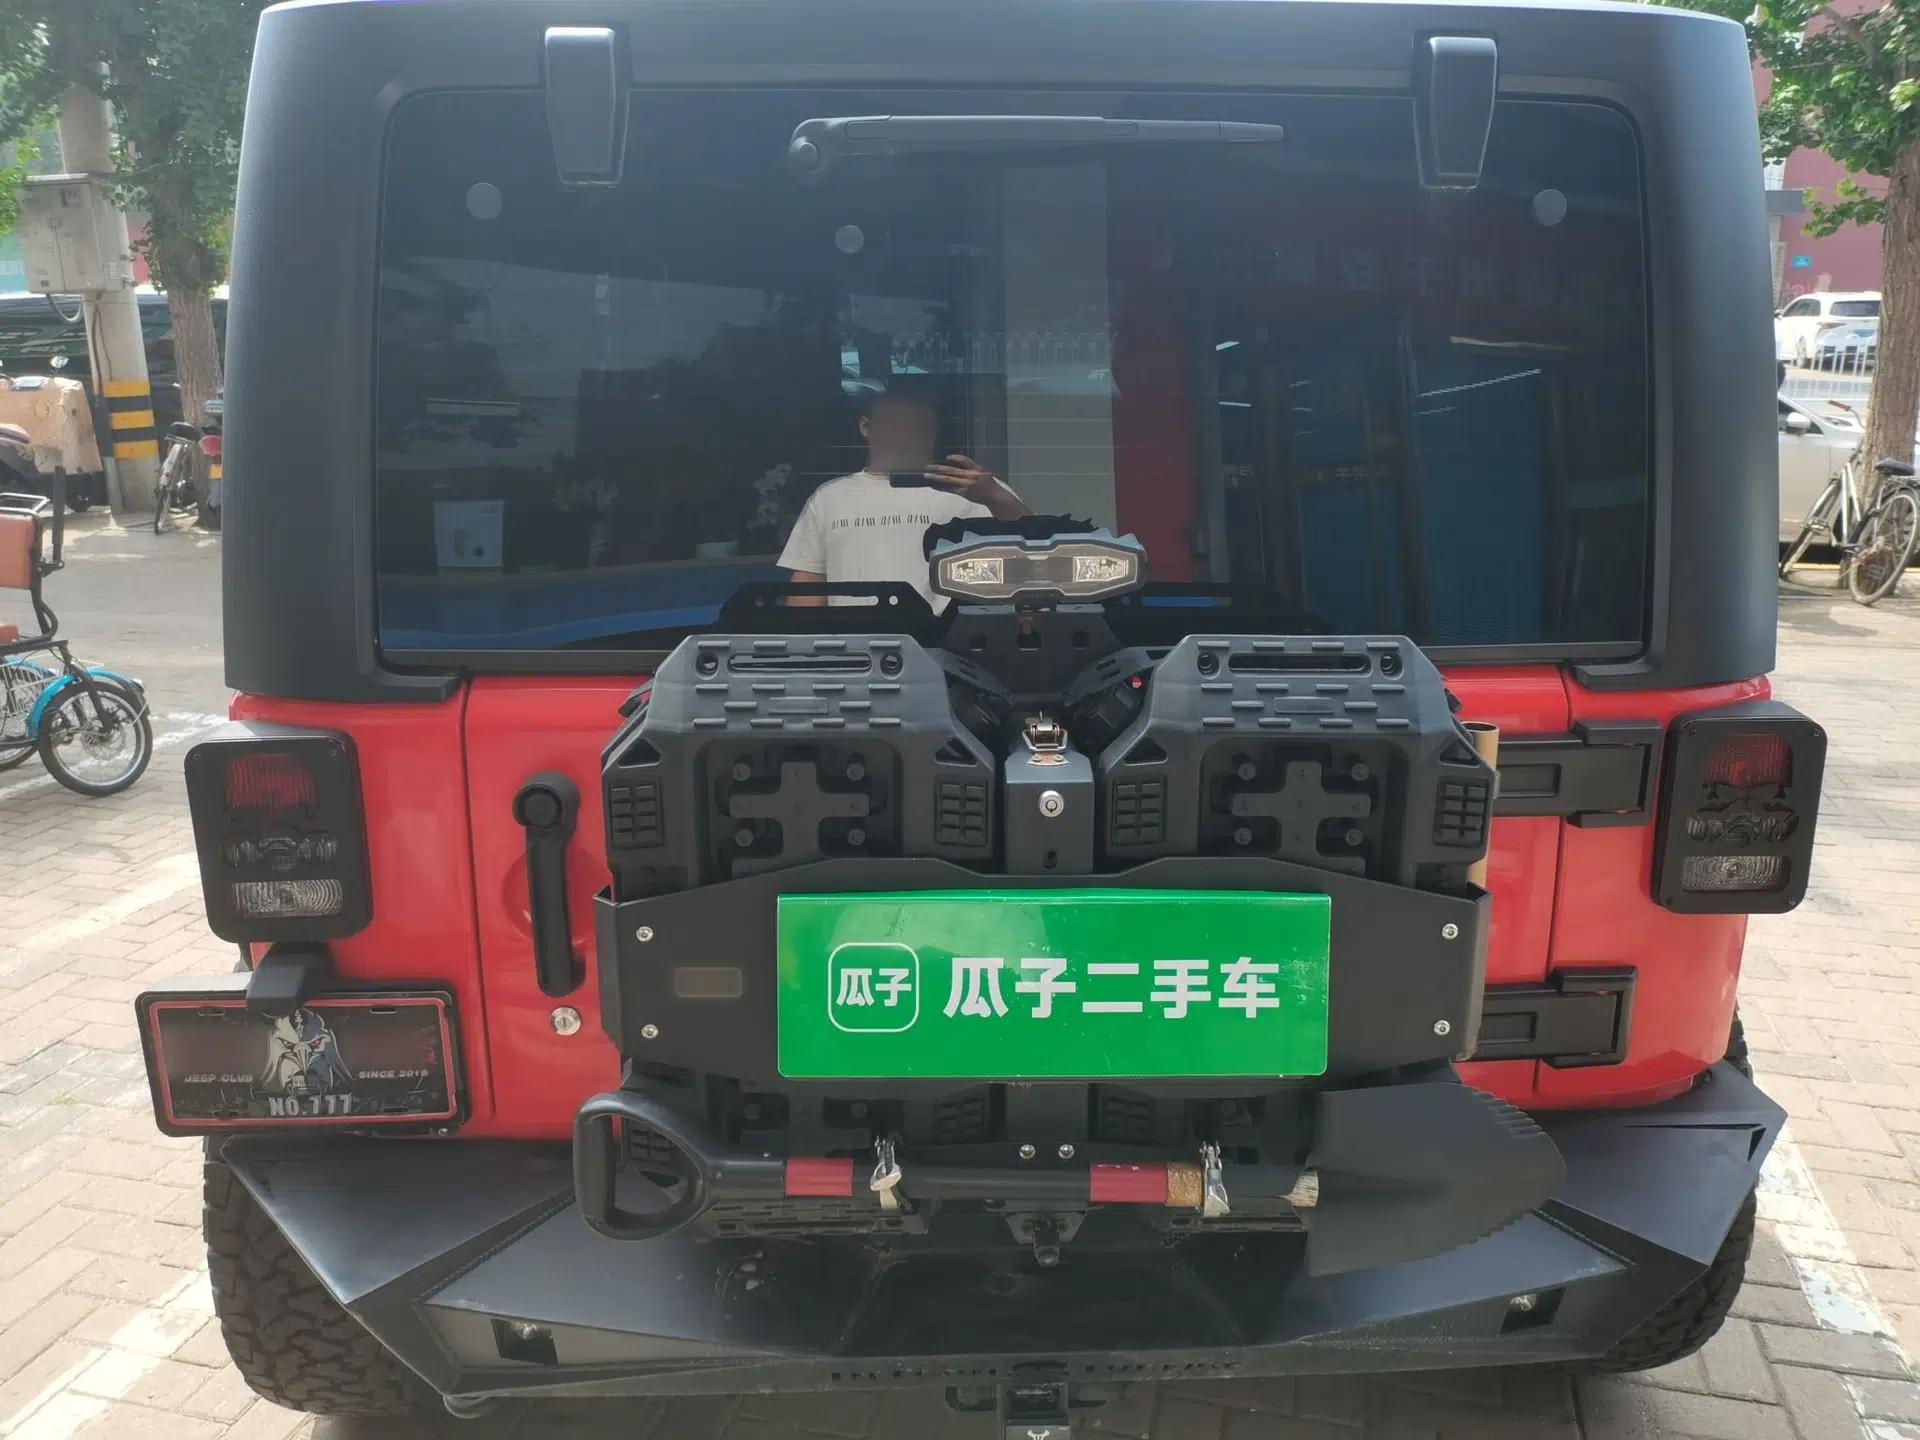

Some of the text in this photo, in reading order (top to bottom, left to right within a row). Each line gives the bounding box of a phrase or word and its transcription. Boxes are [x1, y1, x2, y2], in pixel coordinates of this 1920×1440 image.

[836, 967, 912, 1007] 瓜子
[942, 956, 1280, 1019] 瓜子二手车
[184, 1073, 253, 1083] JEEP CLUB
[358, 1070, 395, 1079] SINCE
[268, 1095, 353, 1117] NO.777
